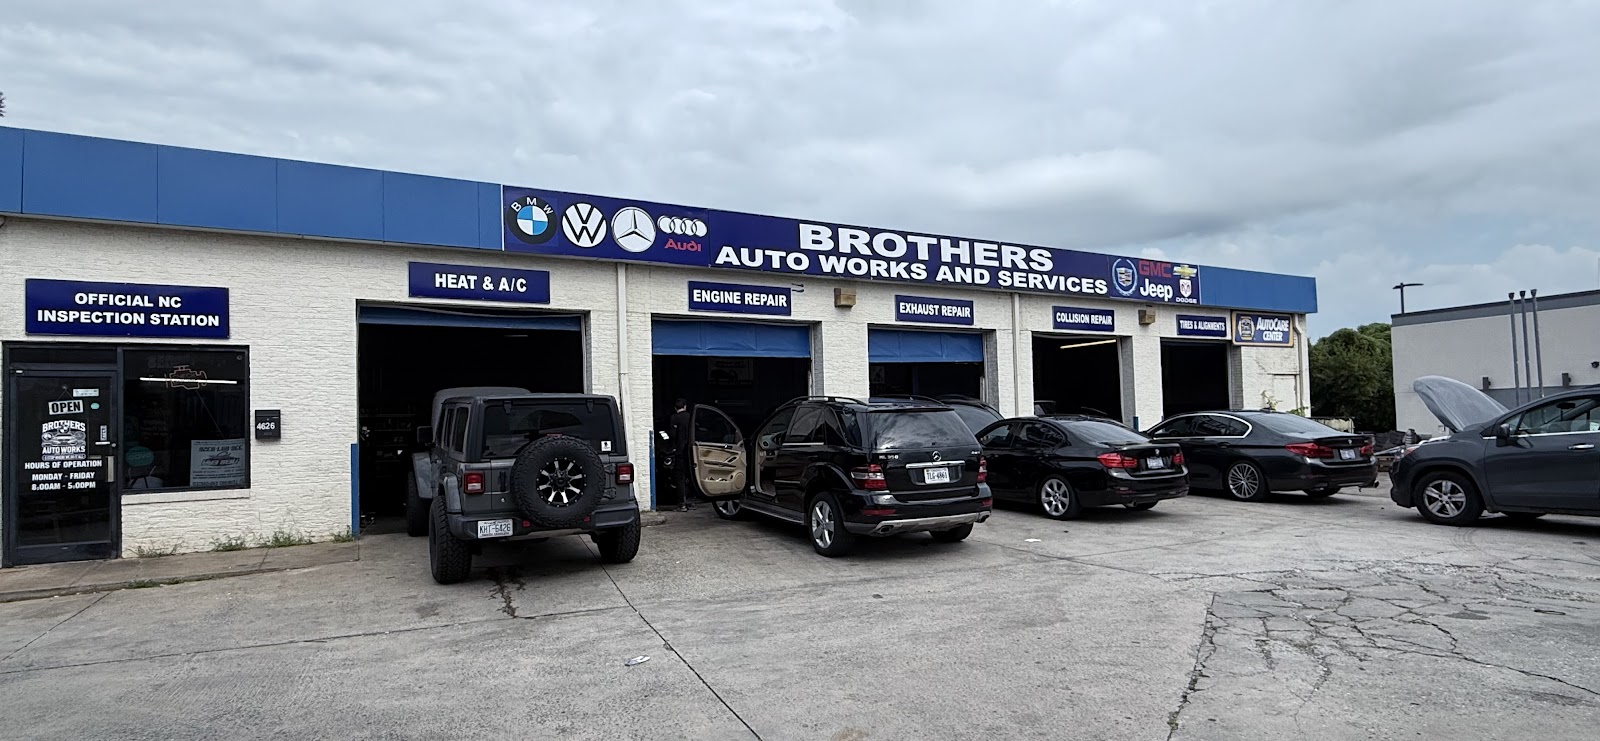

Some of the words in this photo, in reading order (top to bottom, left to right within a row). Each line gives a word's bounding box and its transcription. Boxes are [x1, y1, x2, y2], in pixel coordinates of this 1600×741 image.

[664, 238, 702, 252] Audi
[799, 223, 1053, 272] BROTHERS
[715, 246, 810, 271] AUTO
[818, 254, 927, 280] WORKS
[936, 265, 990, 284] AND
[998, 270, 1108, 295] SERVICES
[1138, 260, 1172, 278] GMC
[435, 273, 477, 290] HEAT
[483, 275, 494, 290] &
[499, 277, 527, 292] A/C
[1140, 278, 1173, 302] Jeep
[75, 292, 153, 307] OFFICIAL
[159, 296, 182, 308] NC
[693, 289, 741, 304] ENGINE
[745, 293, 787, 307] REPAIR
[900, 302, 939, 316] EXHAUST
[941, 305, 971, 318] REPAIR
[37, 310, 145, 325] INSPECTION
[150, 313, 219, 327] STATION
[1056, 312, 1090, 324] COLLISION
[1091, 314, 1112, 326] REPAIR
[1180, 319, 1193, 330] TIRES
[1193, 320, 1198, 330] &
[1198, 320, 1225, 332] ALIGNMENTS
[1263, 331, 1283, 341] CENTER
[52, 401, 81, 413] OPEN
[42, 420, 86, 432] BROTHERS
[257, 422, 275, 430] 4626
[42, 446, 60, 454] AUTO
[63, 460, 102, 468] OPERATION
[32, 473, 63, 481] MONDAY
